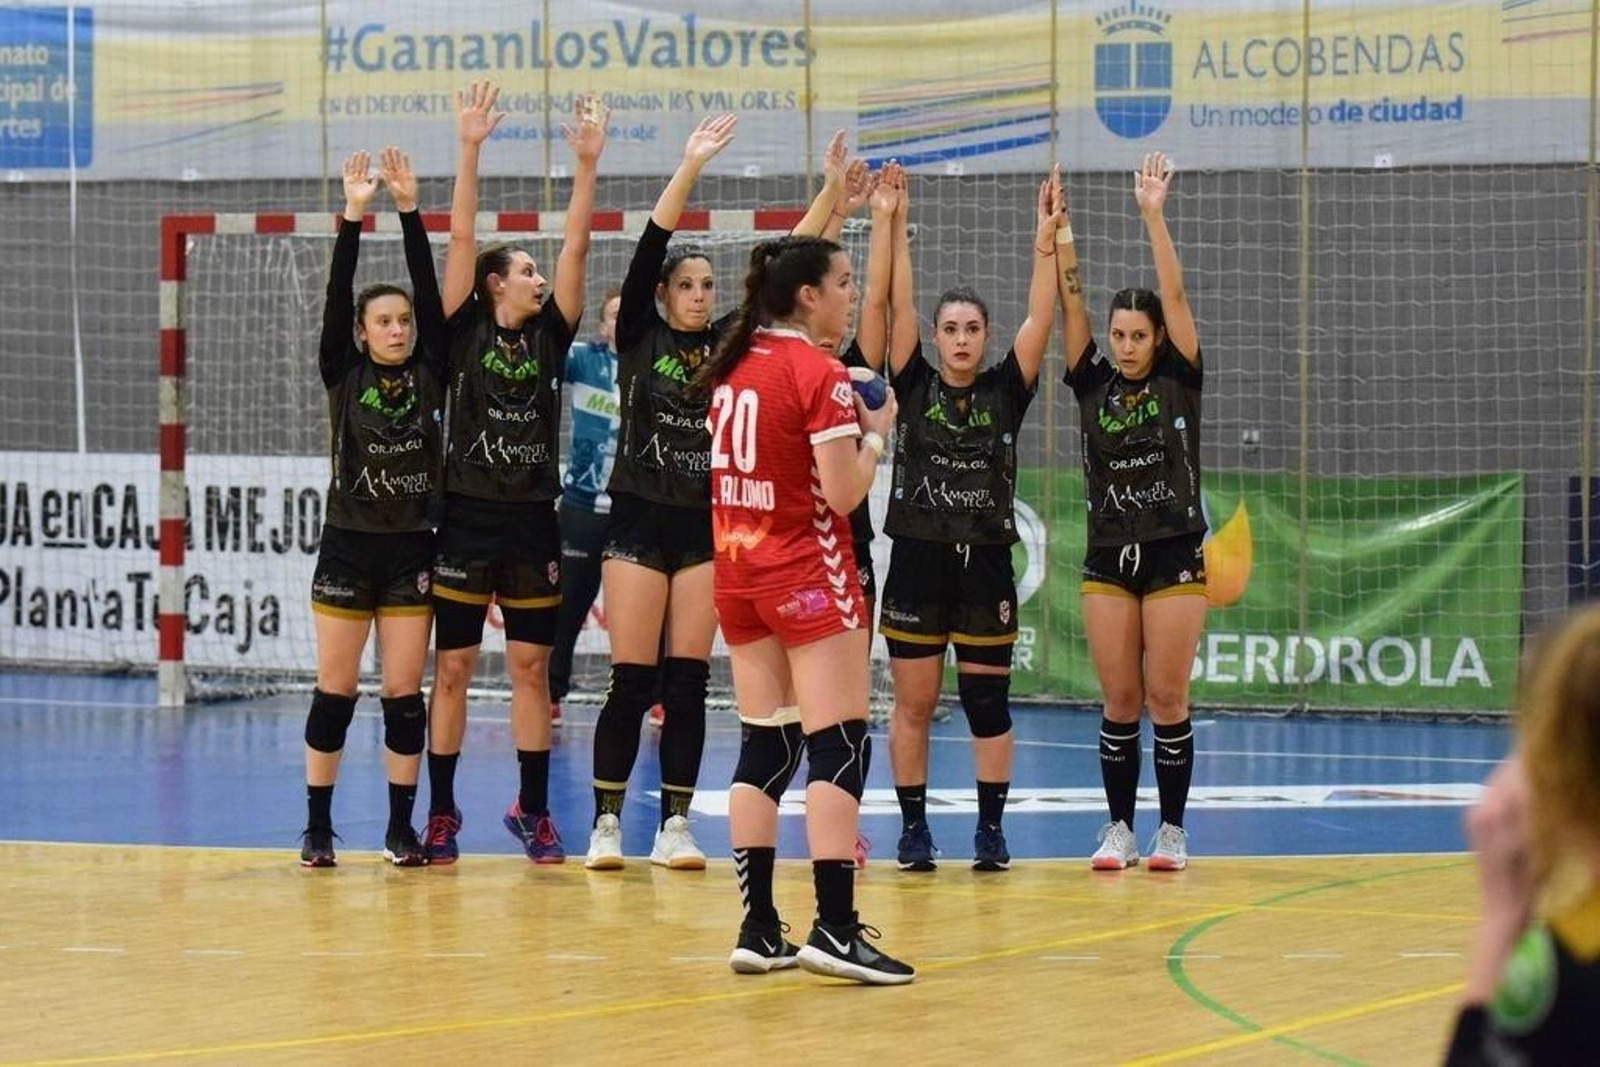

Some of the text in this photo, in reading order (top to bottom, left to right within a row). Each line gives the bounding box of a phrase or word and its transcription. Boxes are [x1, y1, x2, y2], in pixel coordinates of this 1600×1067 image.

[325, 13, 816, 71] #GananLosValores
[1193, 33, 1465, 79] ALCOBENDAS
[698, 90, 797, 111] VALORES
[1189, 95, 1465, 128] Un modelo de ciudad
[711, 384, 759, 474] 20
[720, 475, 775, 511] ALOMO
[964, 498, 996, 508] TECA
[42, 489, 87, 539] en
